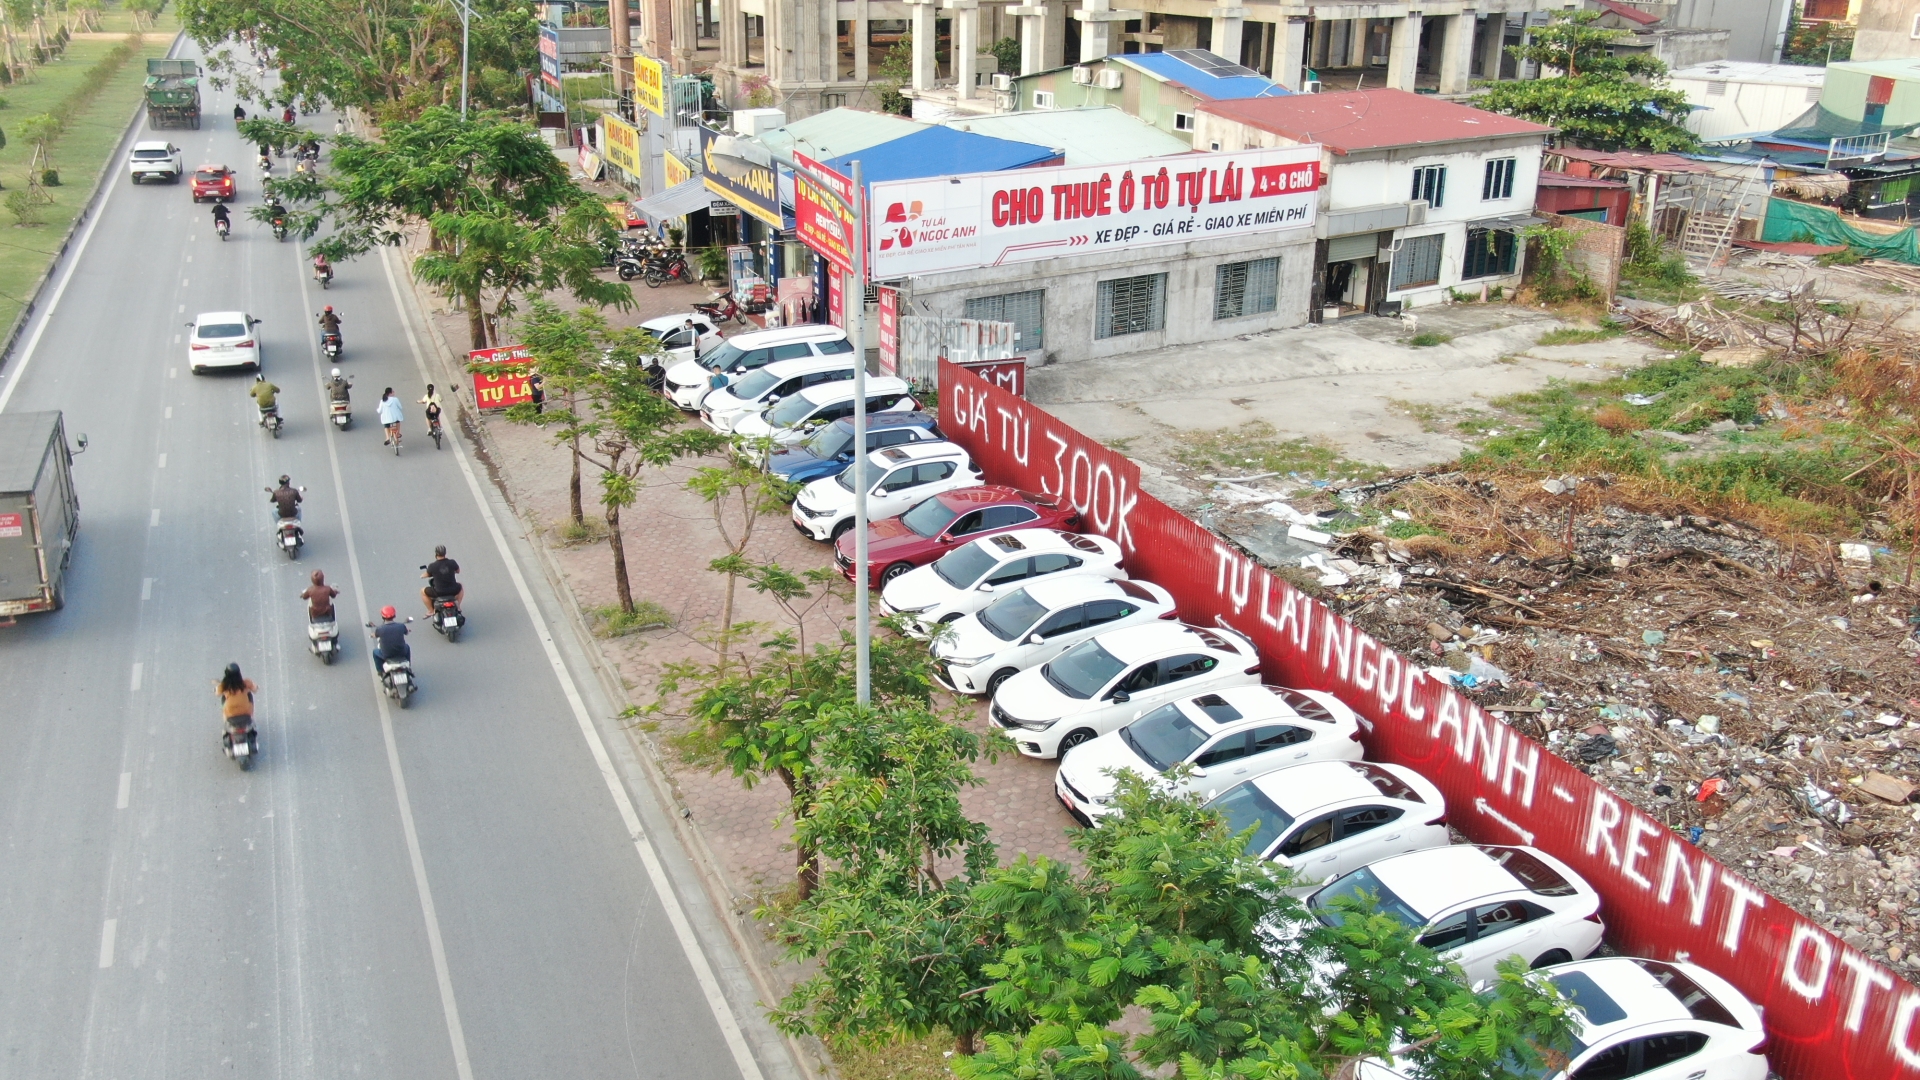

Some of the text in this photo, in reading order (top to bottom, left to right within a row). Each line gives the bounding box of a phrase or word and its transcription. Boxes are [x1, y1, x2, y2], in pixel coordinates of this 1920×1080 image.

[635, 60, 649, 85] HÀNG
[608, 120, 623, 145] HÀNG
[1259, 175, 1268, 192] 4
[1278, 173, 1287, 190] 8
[1289, 163, 1313, 189] CHỖ
[992, 161, 1243, 228] CHO THUÊ Ô TÔ TỰ LÁI
[919, 225, 977, 243] NGỌC ANH
[921, 216, 947, 229] TỰ LÁI
[1094, 229, 1112, 244] XE
[1114, 225, 1140, 243] ĐẸP
[1152, 218, 1174, 236] GIÁ
[1177, 216, 1194, 234] RẺ
[1205, 215, 1234, 230] GIAO
[1236, 213, 1253, 227] XE
[1254, 206, 1284, 225] MIỄN
[1286, 204, 1309, 221] PHÍ
[479, 380, 533, 403] TỰ LÁ
[954, 384, 1138, 553] GIÁ TỪ 300K
[1214, 543, 1254, 615] TỰ
[1260, 570, 1312, 653] LÁI
[1322, 611, 1426, 722] NGỌC
[1432, 690, 1540, 808] ANH
[1586, 788, 1765, 954] RENT
